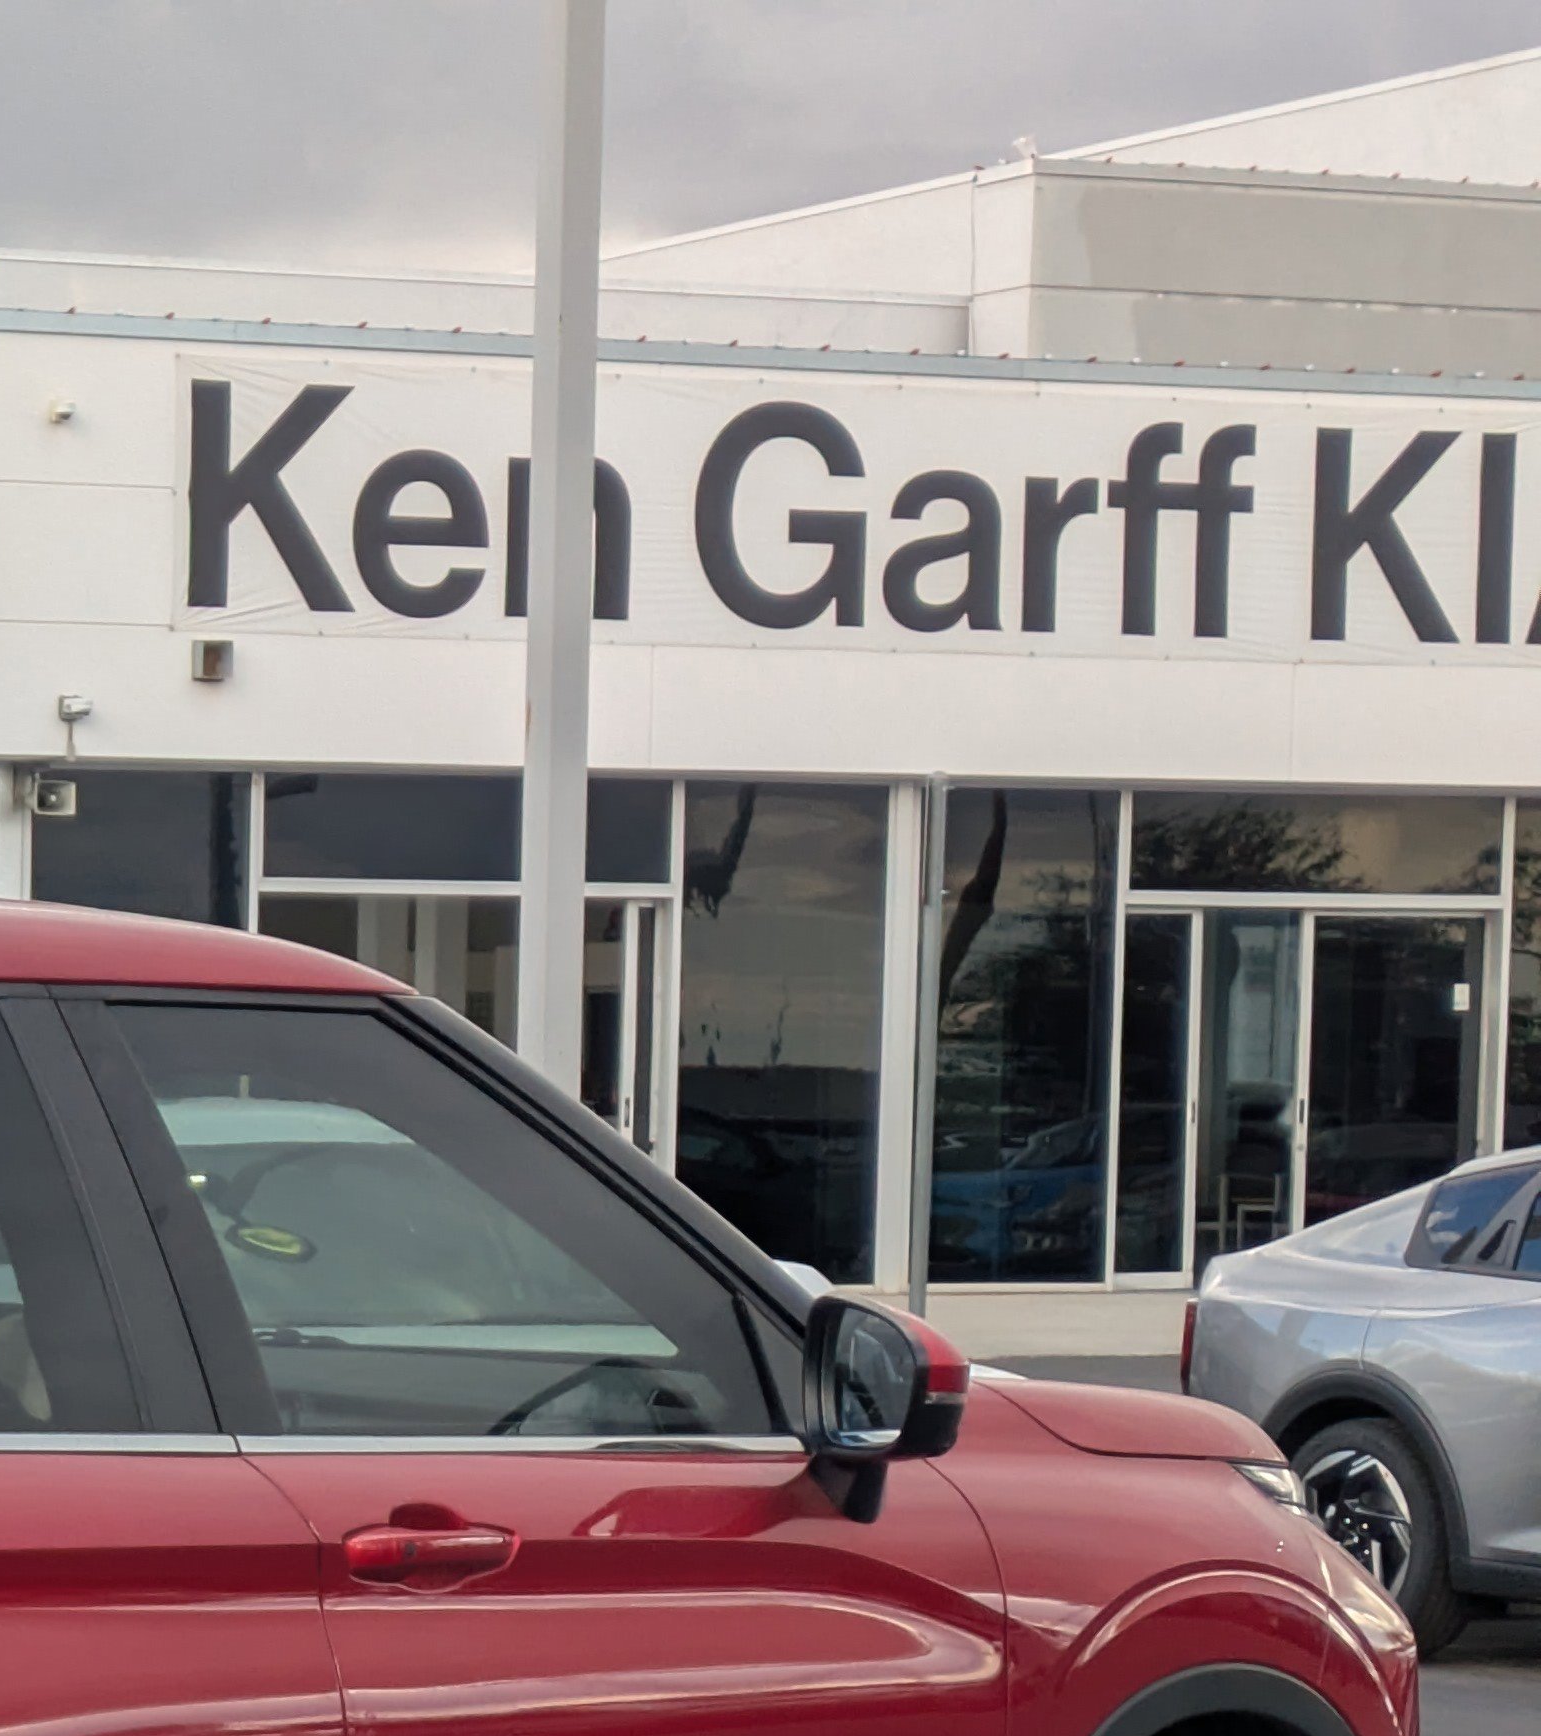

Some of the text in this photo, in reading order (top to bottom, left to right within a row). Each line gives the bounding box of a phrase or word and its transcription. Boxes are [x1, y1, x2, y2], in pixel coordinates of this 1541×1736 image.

[187, 378, 1541, 645] Ken Garff KI
